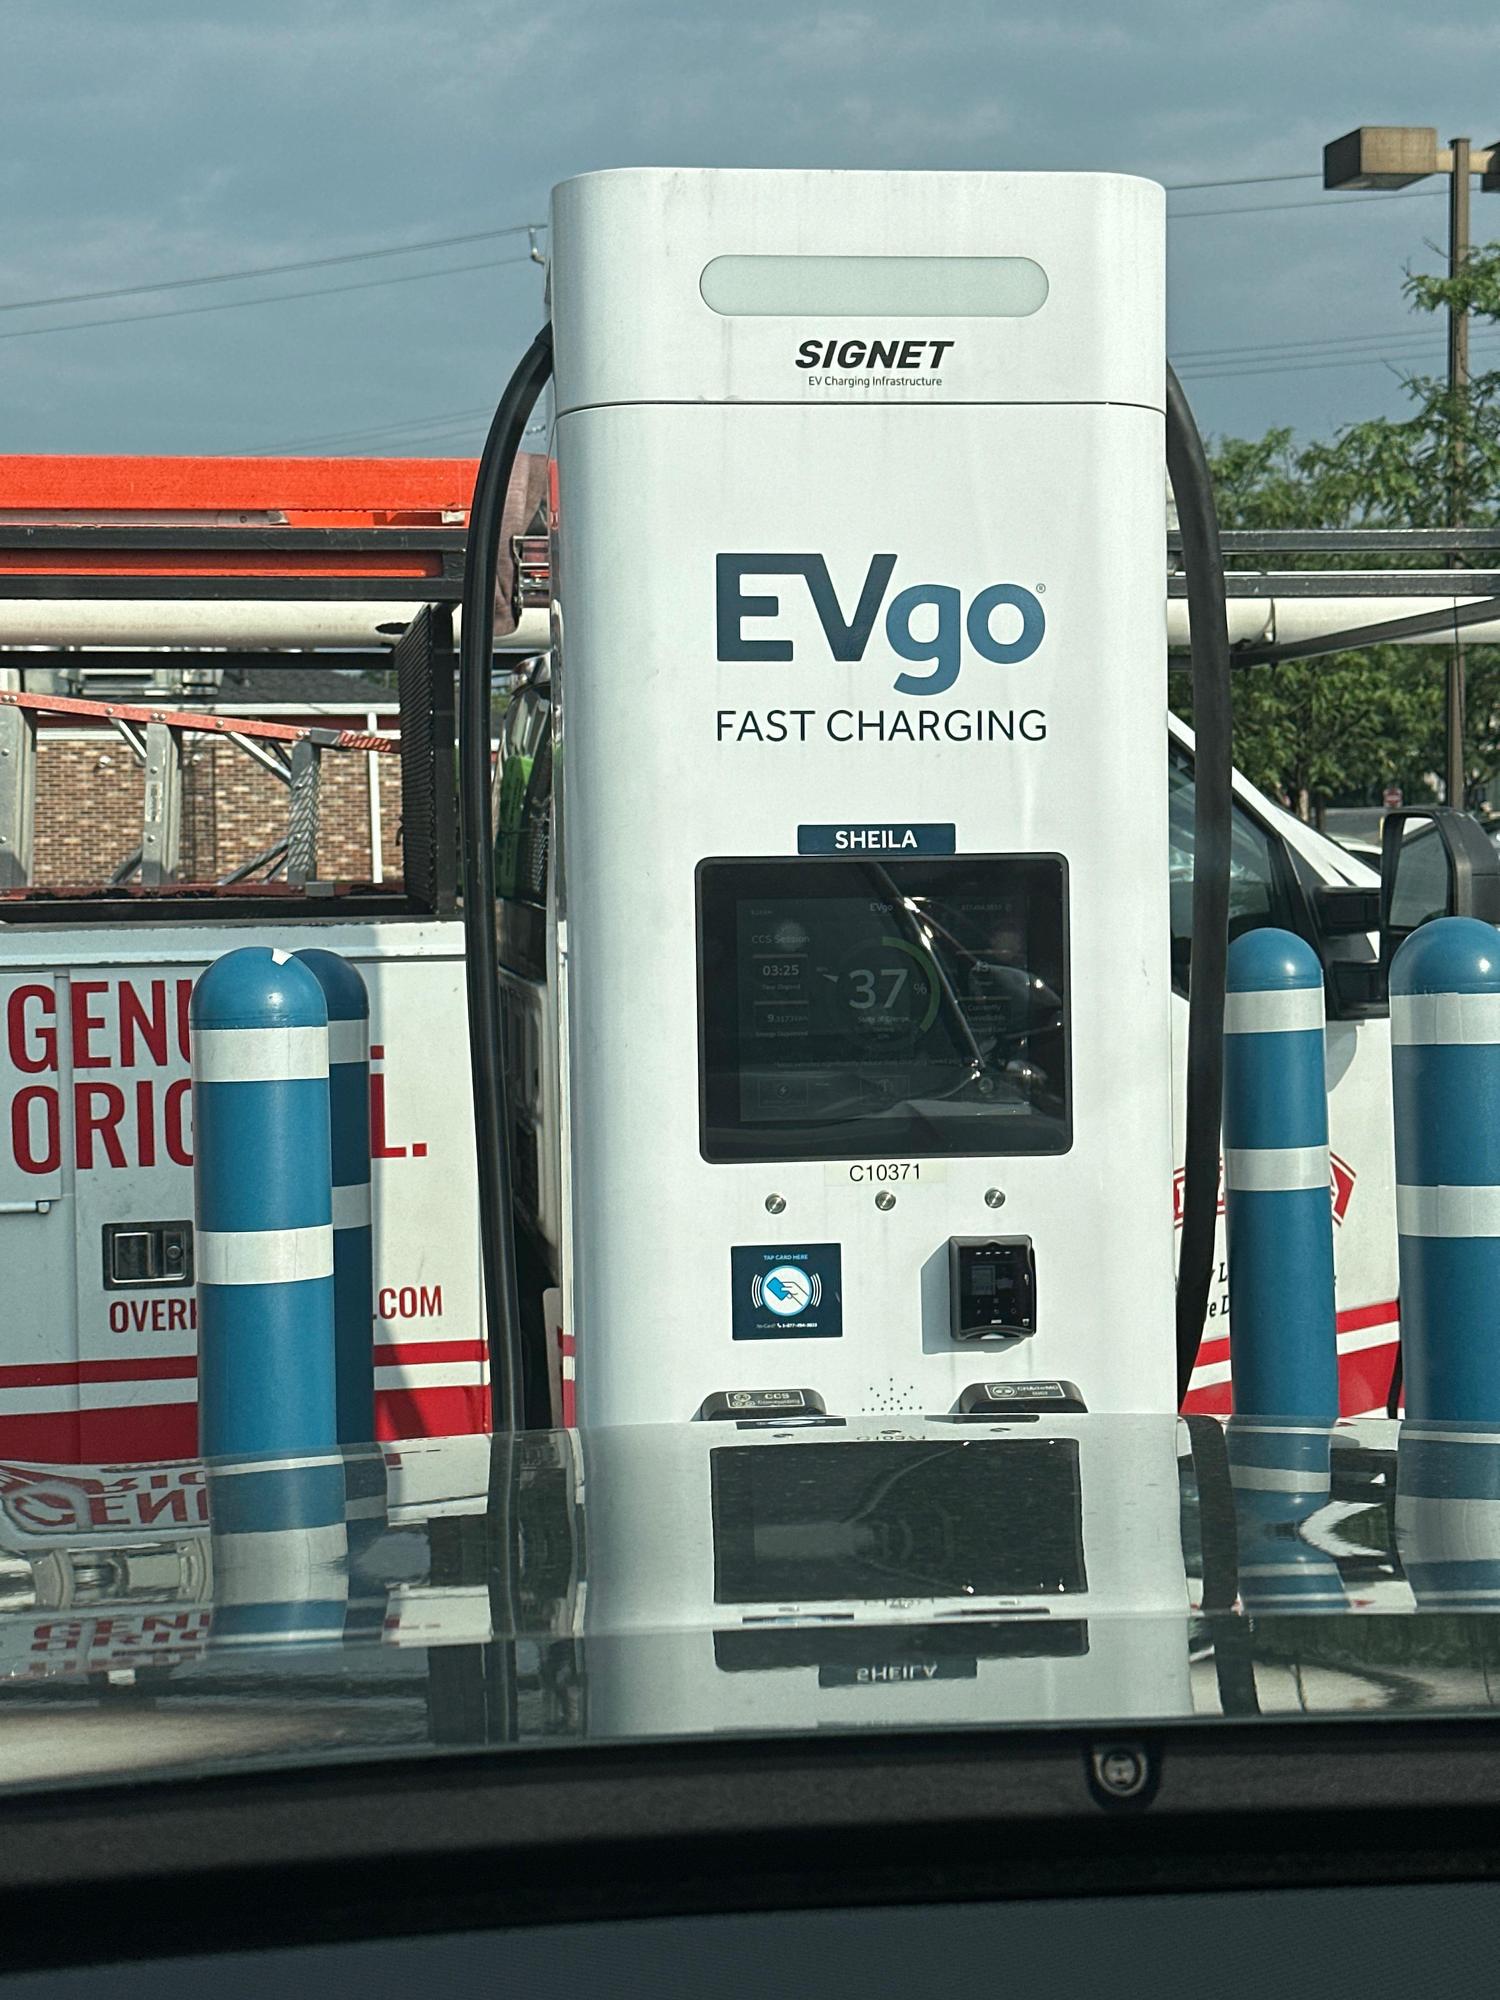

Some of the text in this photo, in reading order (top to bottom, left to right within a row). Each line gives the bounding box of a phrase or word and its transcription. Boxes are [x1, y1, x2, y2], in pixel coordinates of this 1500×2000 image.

[795, 340, 955, 369] SIGNET
[808, 375, 942, 389] EV Charging Infrastructure
[716, 709, 1047, 742] FAST CHARGING
[834, 829, 918, 849] SHEILA
[751, 934, 773, 944] CCS
[762, 964, 800, 977] 03:25
[848, 968, 909, 1010] 37
[849, 1163, 922, 1183] C10371
